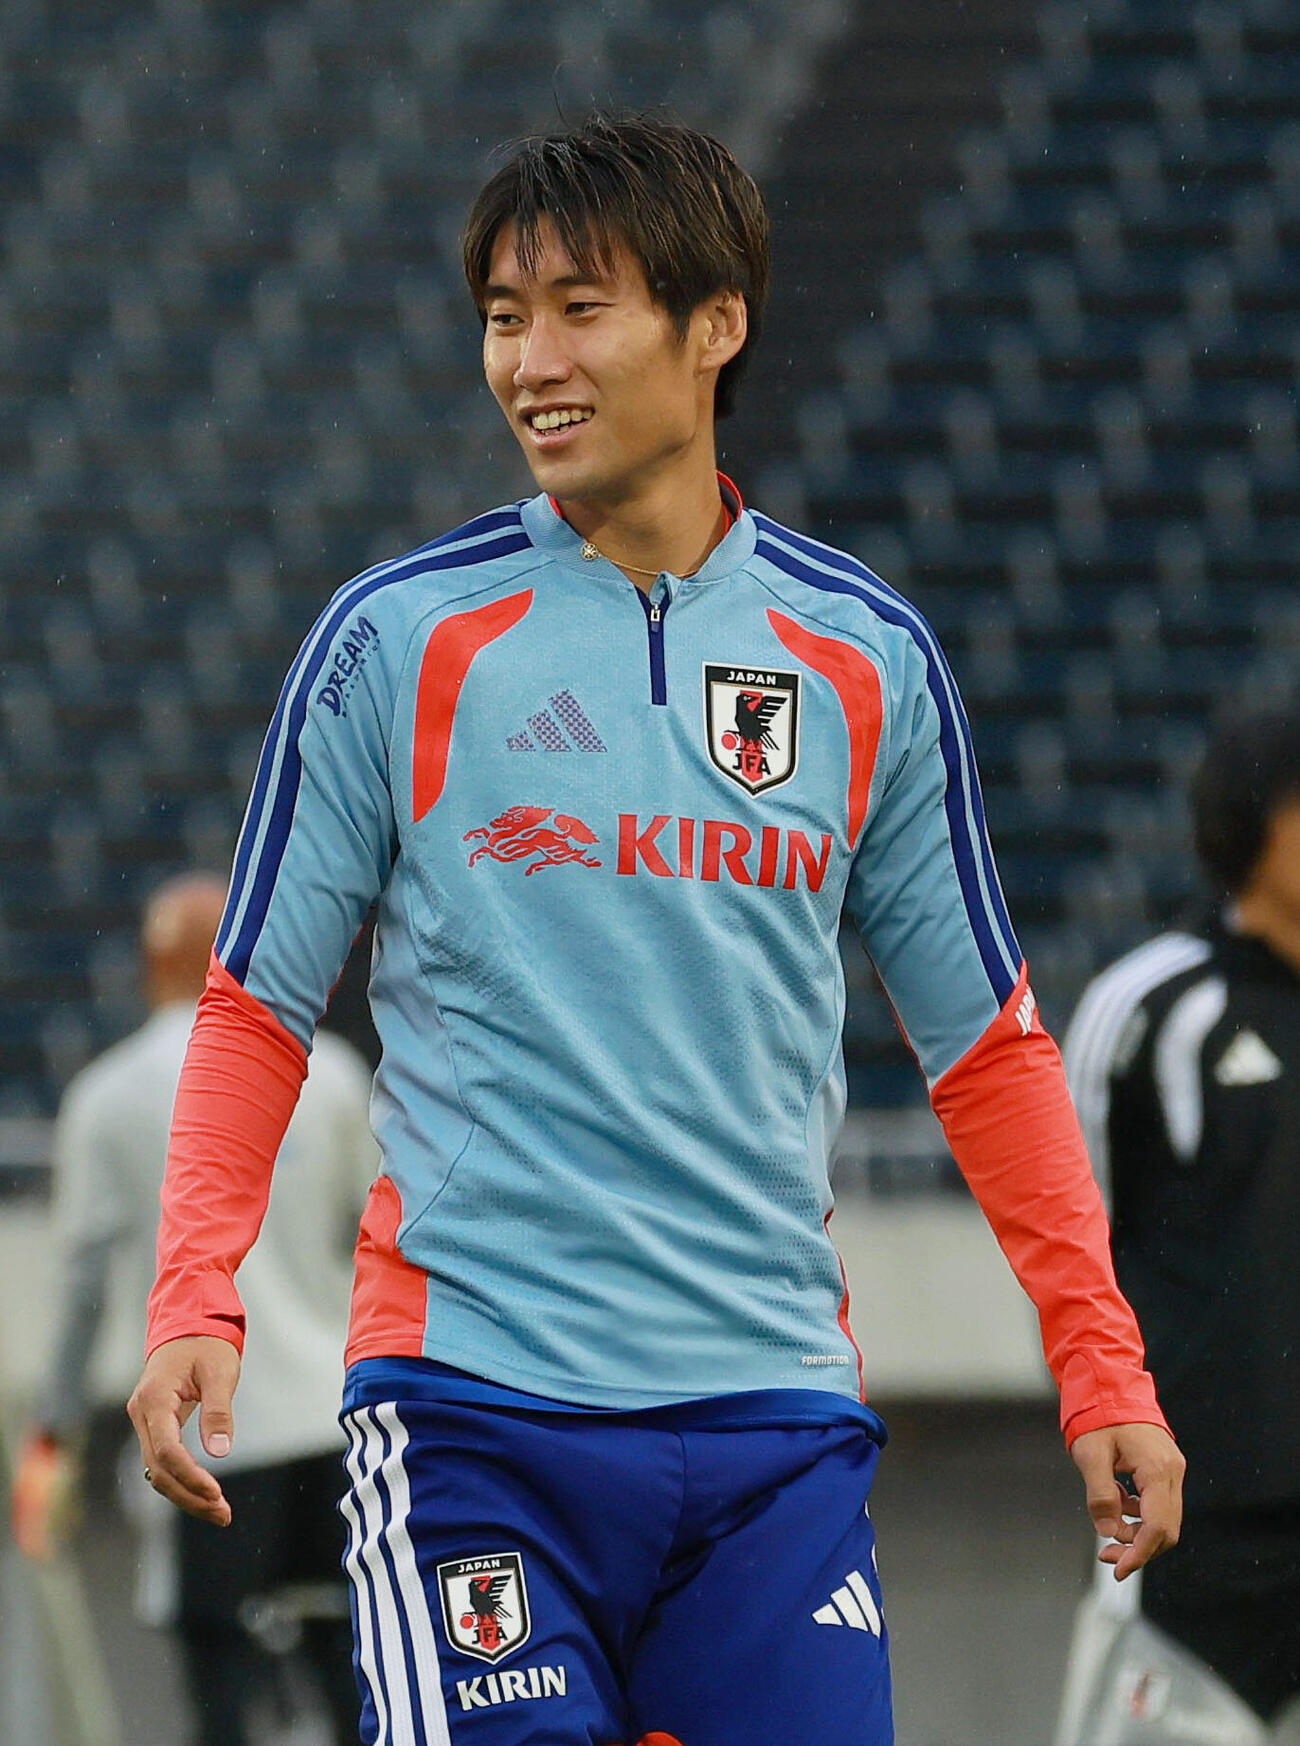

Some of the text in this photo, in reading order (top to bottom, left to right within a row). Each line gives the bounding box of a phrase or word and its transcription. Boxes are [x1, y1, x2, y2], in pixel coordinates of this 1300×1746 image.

[317, 616, 378, 716] DREAM
[727, 671, 777, 685] JAPAN
[732, 753, 772, 776] JFA
[616, 813, 833, 893] KIRIN
[801, 1355, 849, 1365] FORMOTION
[458, 1559, 501, 1574] JAPAN
[471, 1626, 508, 1645] JFA
[456, 1665, 567, 1712] KIRIN
